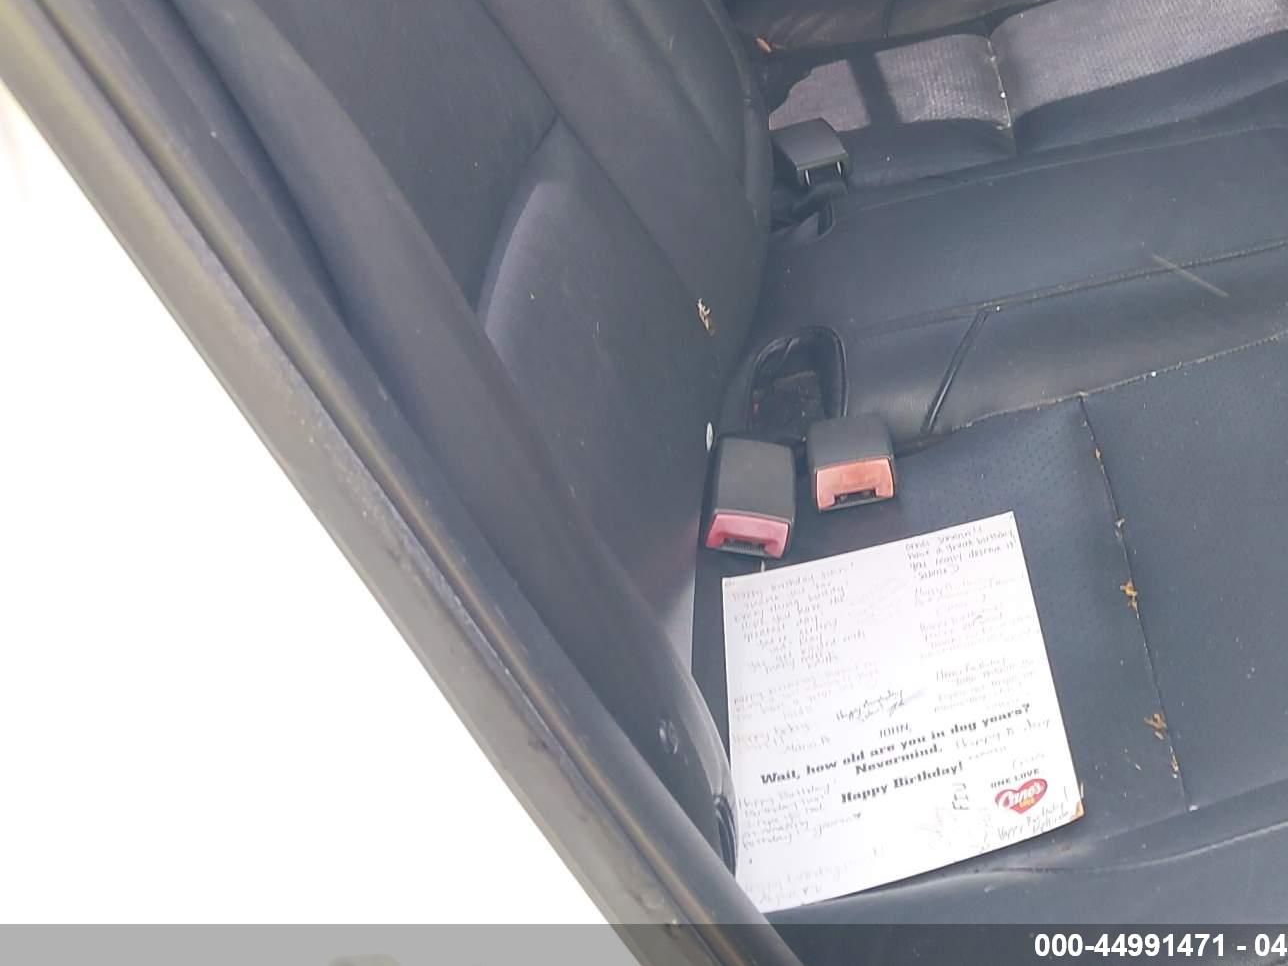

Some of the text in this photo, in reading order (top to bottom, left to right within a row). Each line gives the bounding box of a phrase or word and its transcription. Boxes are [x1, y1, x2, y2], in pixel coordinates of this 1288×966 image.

[760, 703, 1030, 784] Wait, how old are you in dog years?
[855, 743, 943, 775] Nevermind.
[841, 761, 963, 804] Happy Birthday!
[1014, 768, 1041, 782] LOVE
